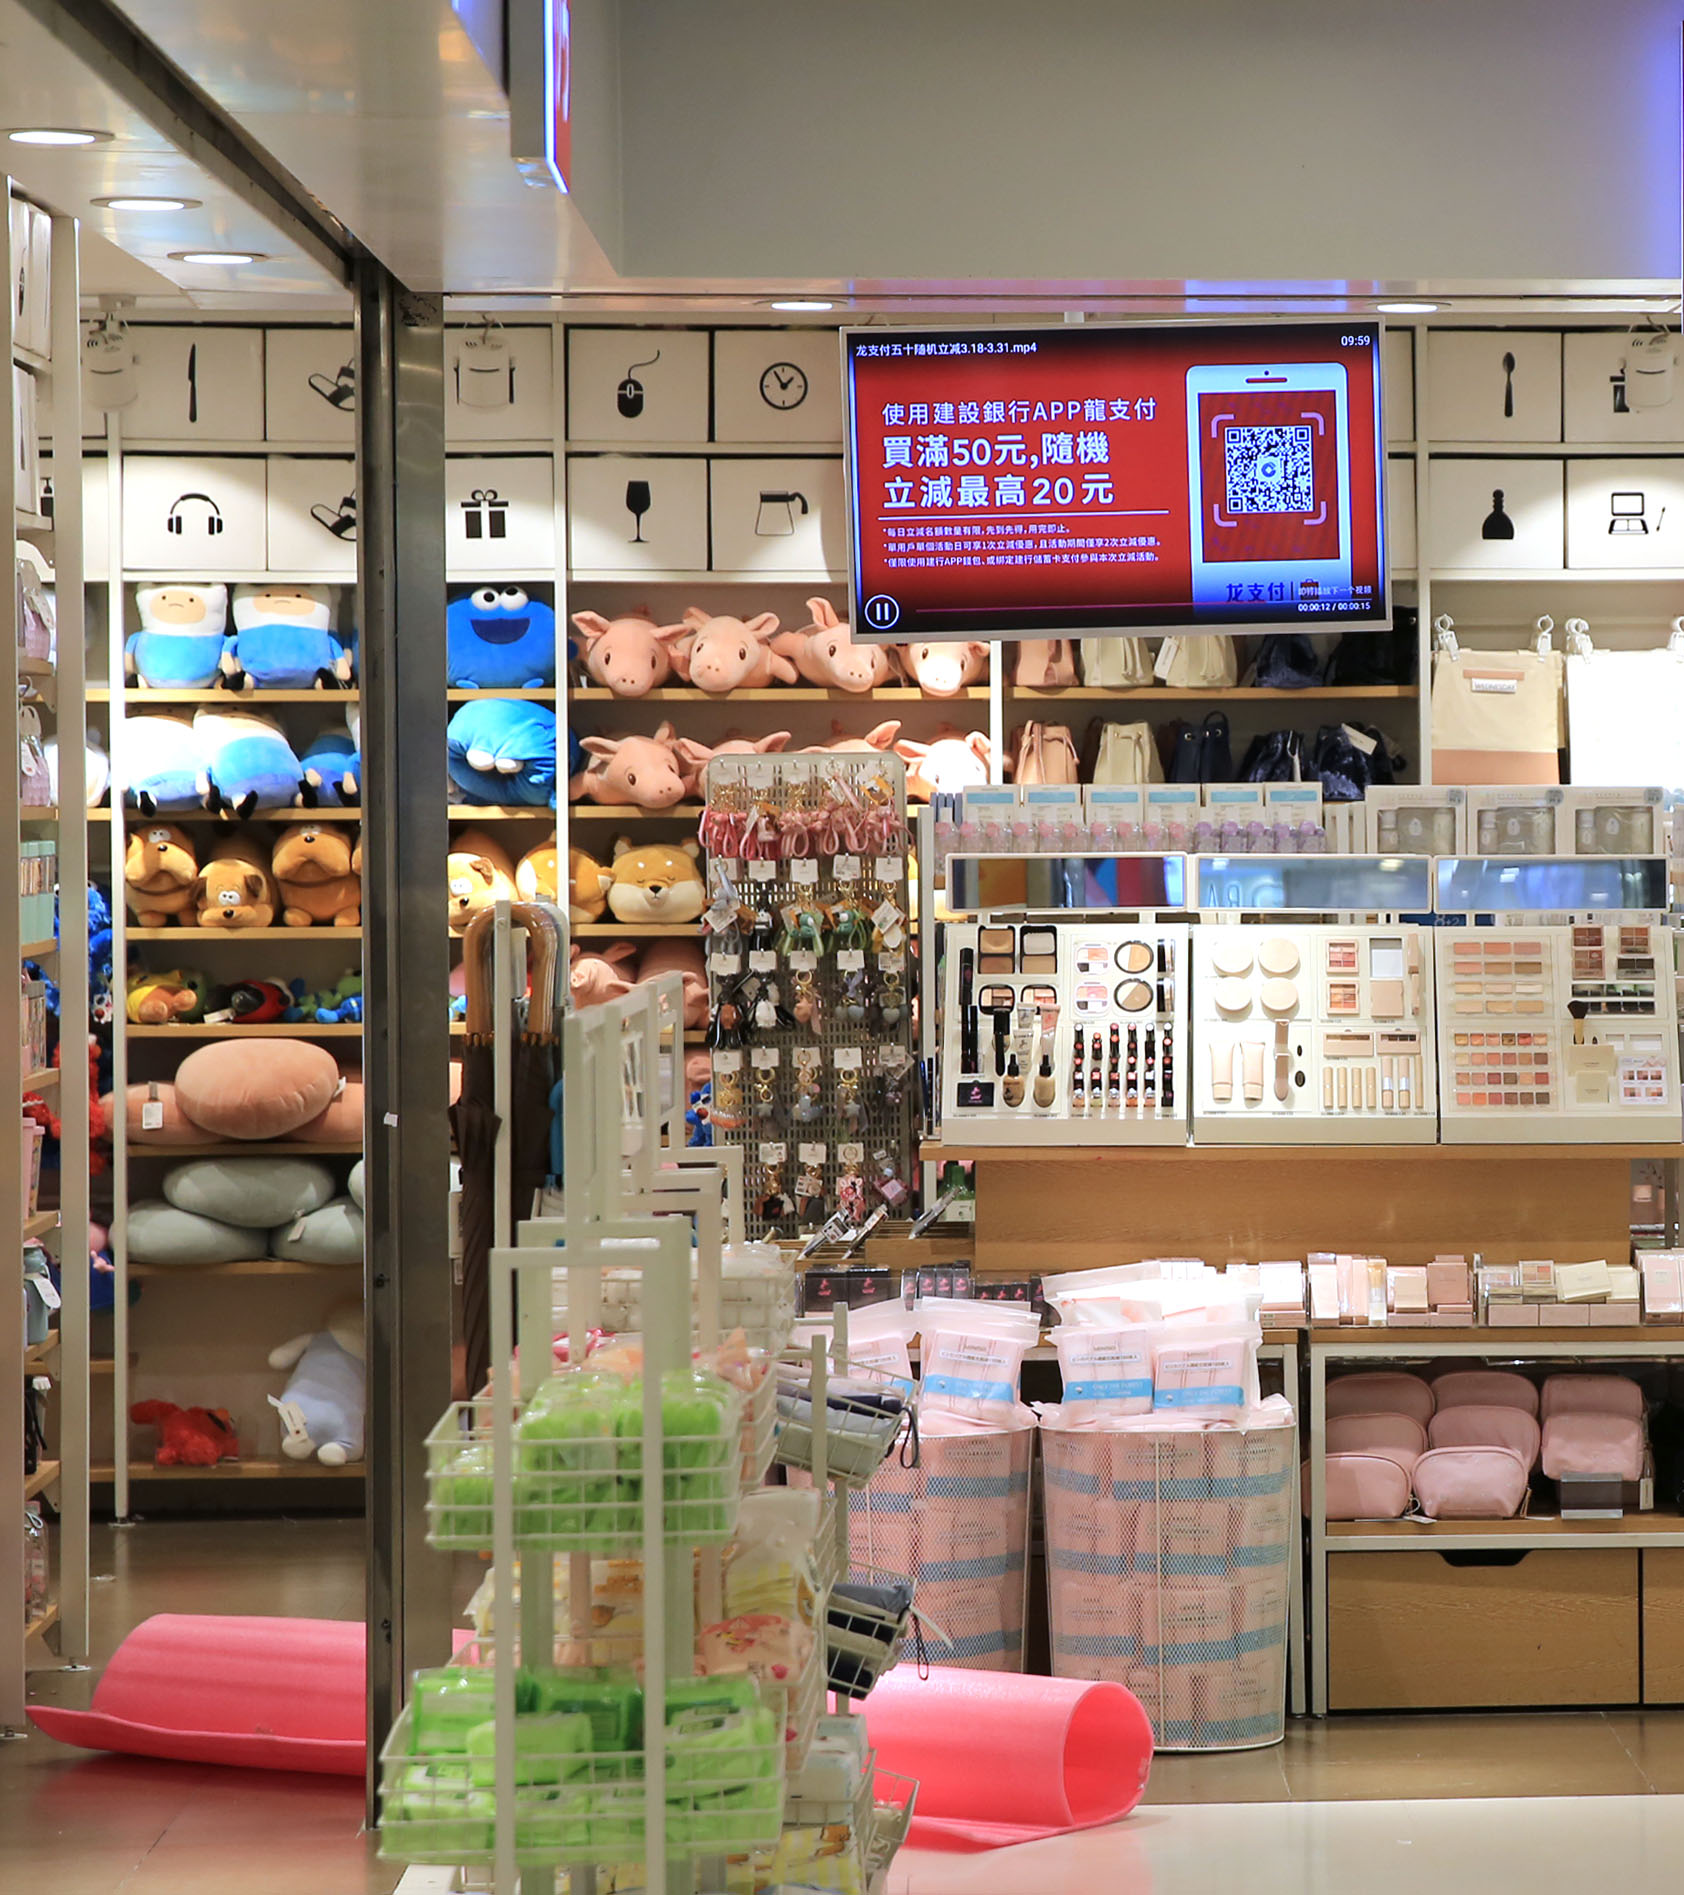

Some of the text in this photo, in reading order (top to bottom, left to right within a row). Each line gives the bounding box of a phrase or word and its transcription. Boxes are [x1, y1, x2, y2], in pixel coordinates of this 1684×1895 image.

[1341, 335, 1371, 348] 09:59
[882, 397, 1157, 426] 使用建設銀行APP龍支付
[882, 431, 1110, 469] 買滿50元,隨機
[883, 473, 1114, 509] 立減最高20元
[1226, 582, 1285, 601] 龙支付
[1298, 602, 1331, 612] 00:00:12
[1337, 601, 1371, 611] 00:00:15
